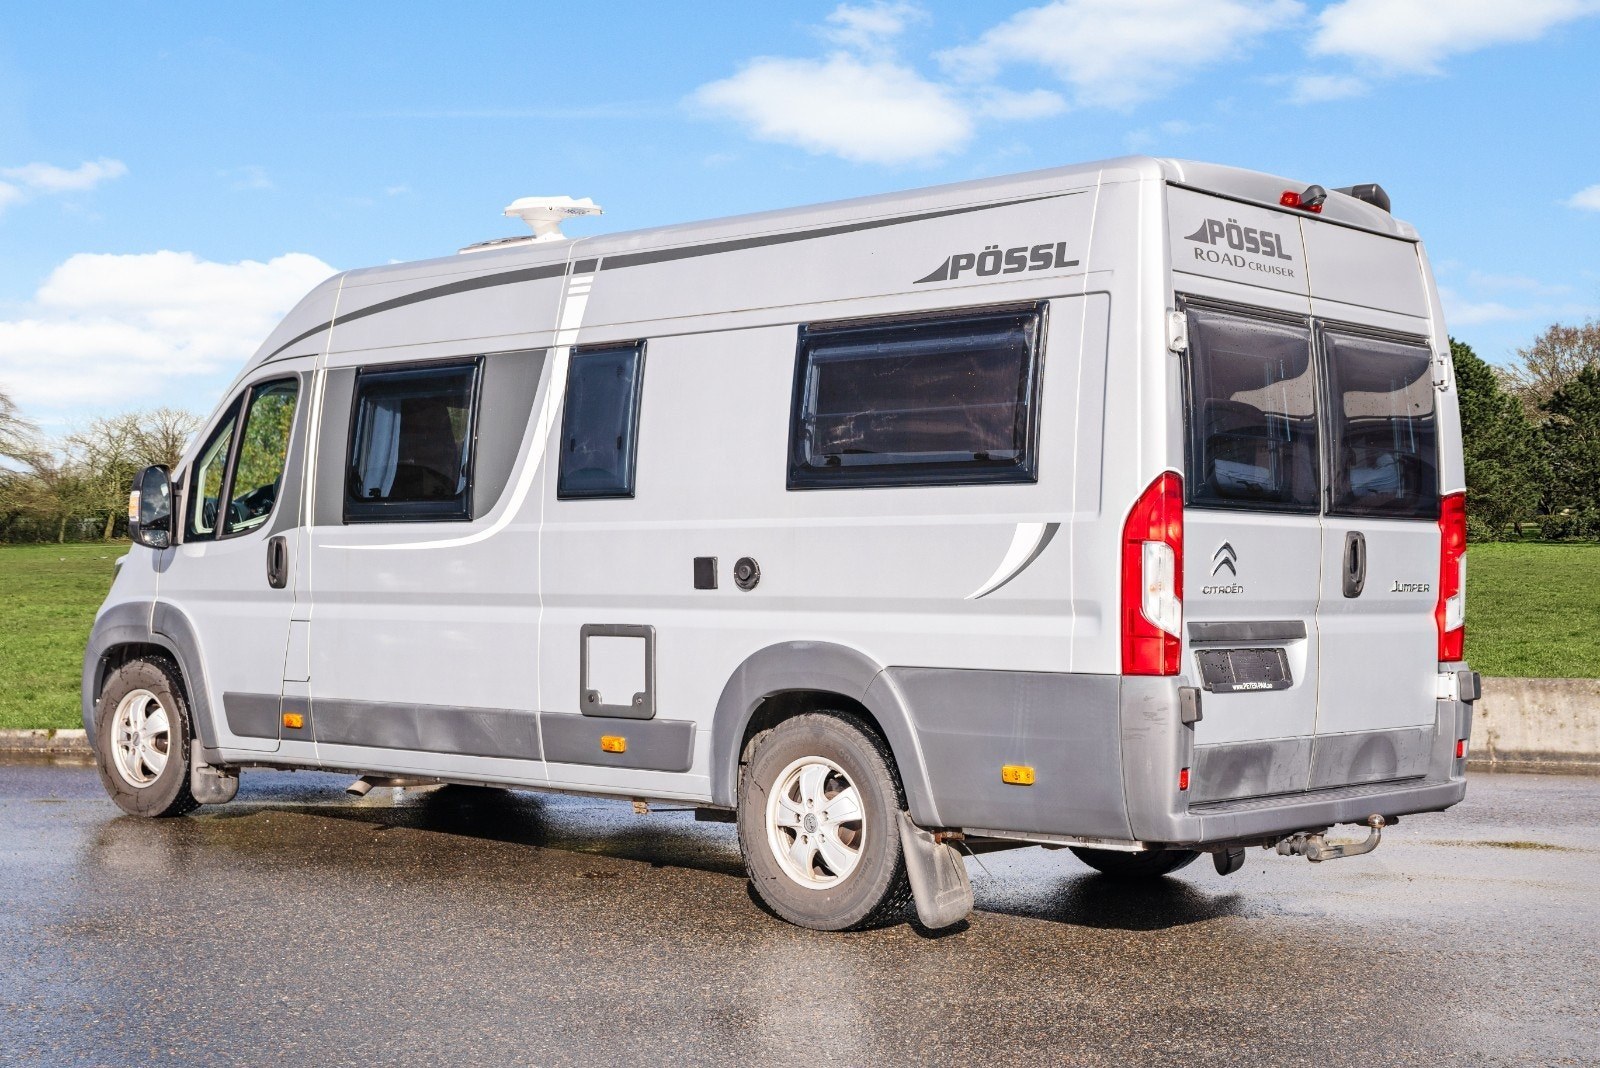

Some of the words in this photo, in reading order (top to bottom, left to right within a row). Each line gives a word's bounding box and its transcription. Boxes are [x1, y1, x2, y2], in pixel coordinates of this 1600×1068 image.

[1207, 217, 1293, 261] PÖSSL
[950, 242, 1080, 280] PÖSSL
[1193, 246, 1246, 269] ROAD
[1248, 261, 1295, 278] CRUISER
[1202, 582, 1244, 595] CITROËN
